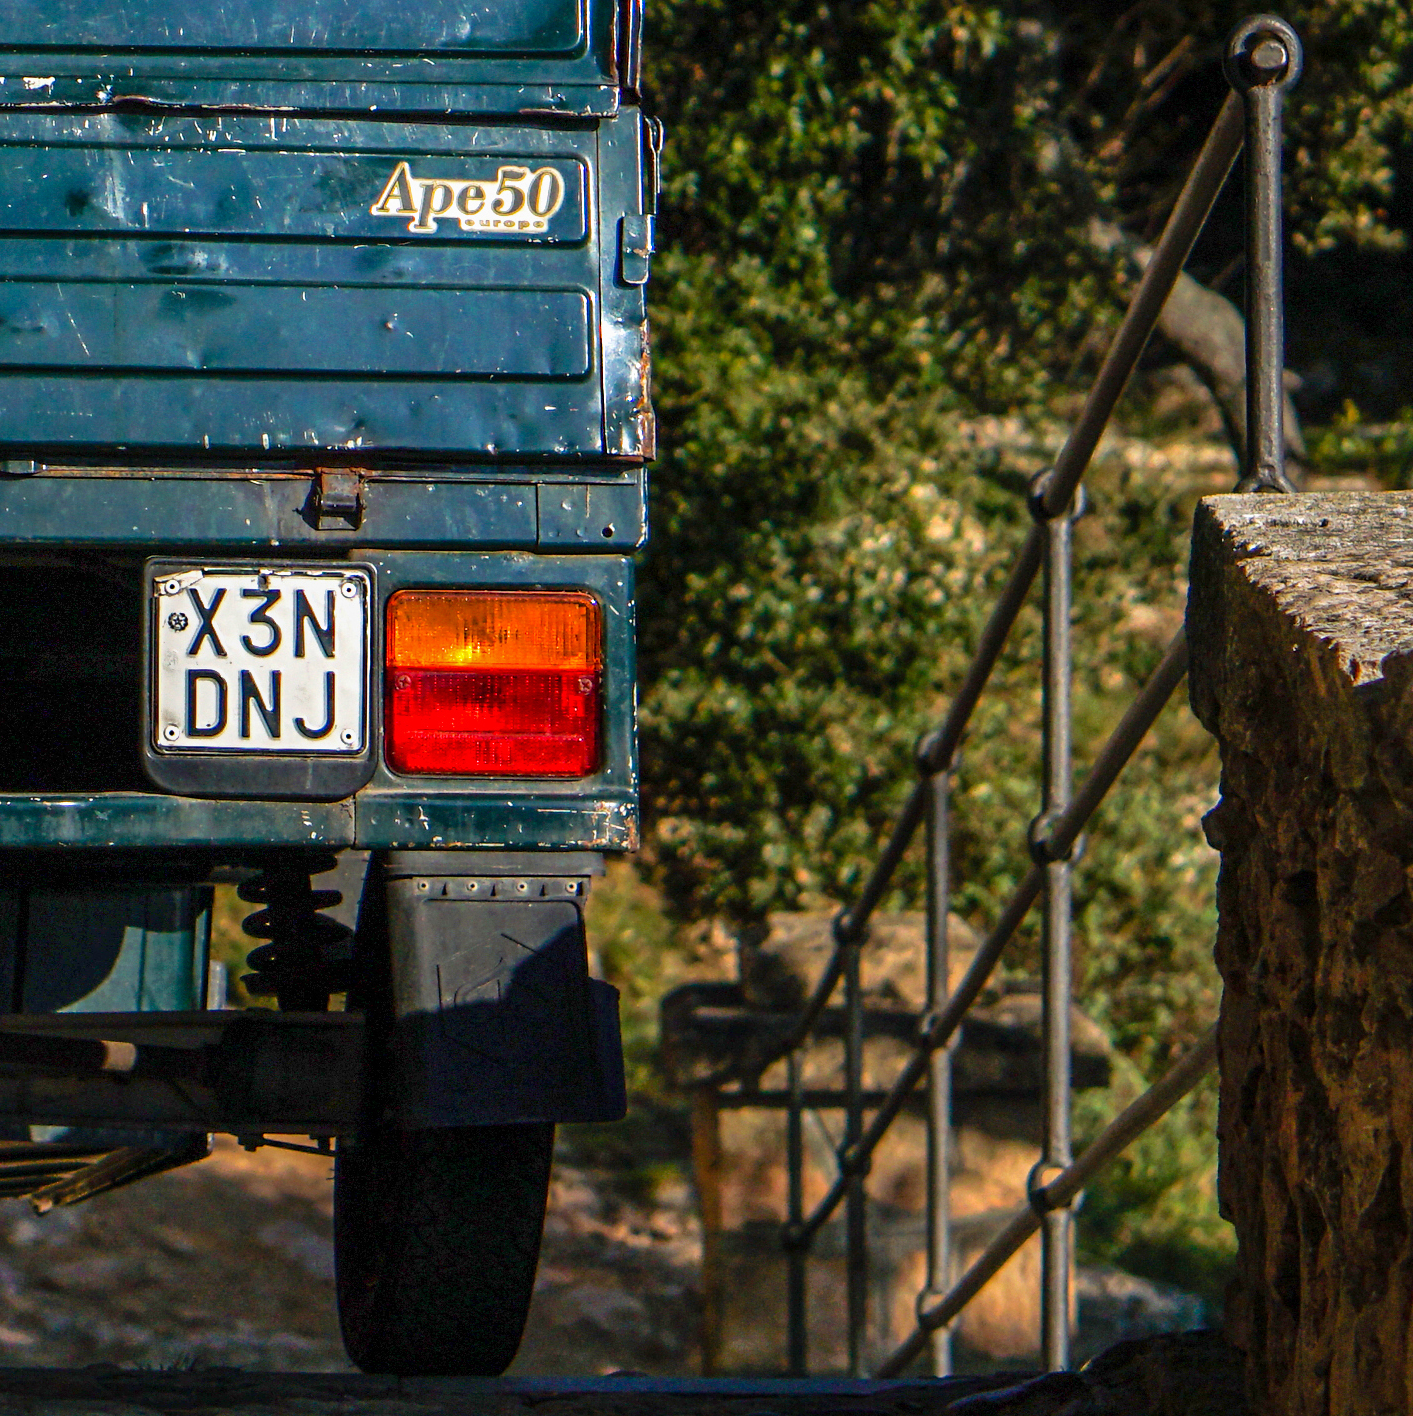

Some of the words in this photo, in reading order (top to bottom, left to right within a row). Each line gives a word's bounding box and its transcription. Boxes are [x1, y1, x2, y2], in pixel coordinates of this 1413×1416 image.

[463, 217, 546, 230] europe
[186, 586, 337, 660] X3N
[184, 668, 337, 741] DNJ
